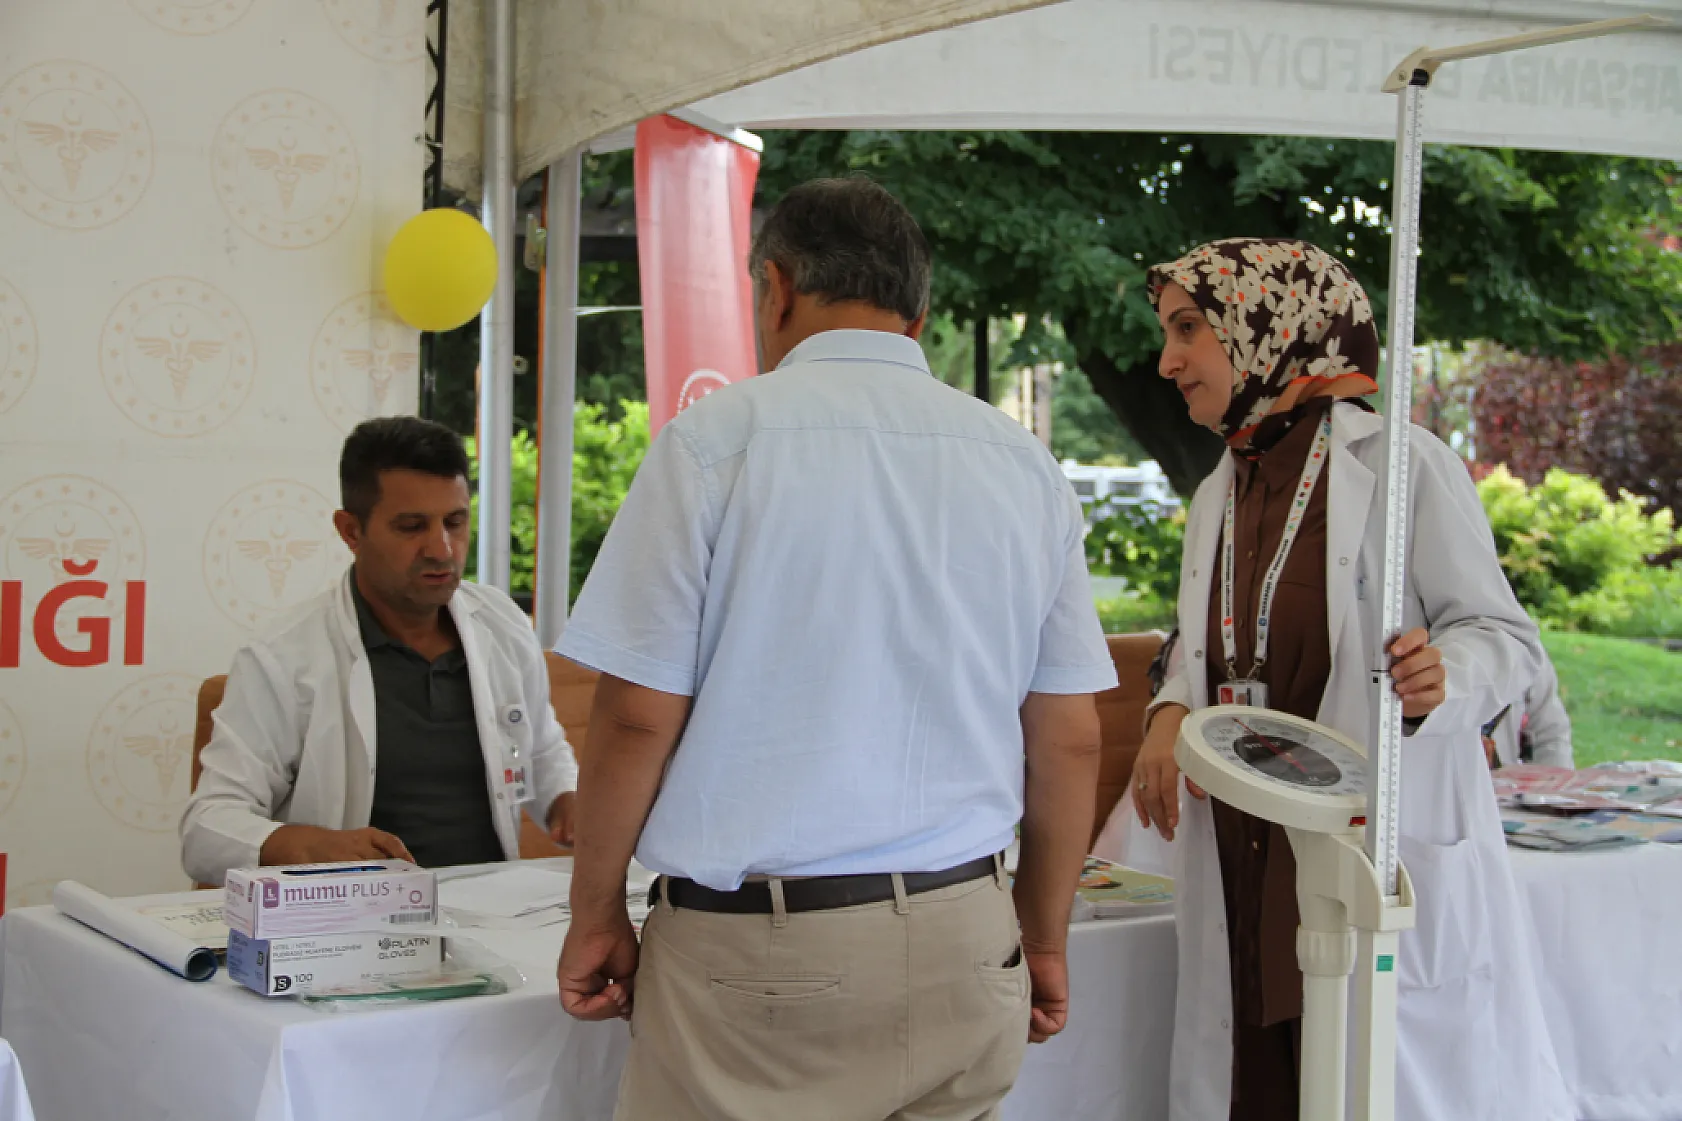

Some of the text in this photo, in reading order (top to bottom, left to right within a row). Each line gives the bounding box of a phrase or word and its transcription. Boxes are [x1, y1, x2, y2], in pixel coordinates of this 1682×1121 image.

[284, 883, 348, 902] mumu
[352, 881, 390, 898] PLUS
[378, 948, 417, 960] GLOVES
[294, 973, 313, 983] 100
